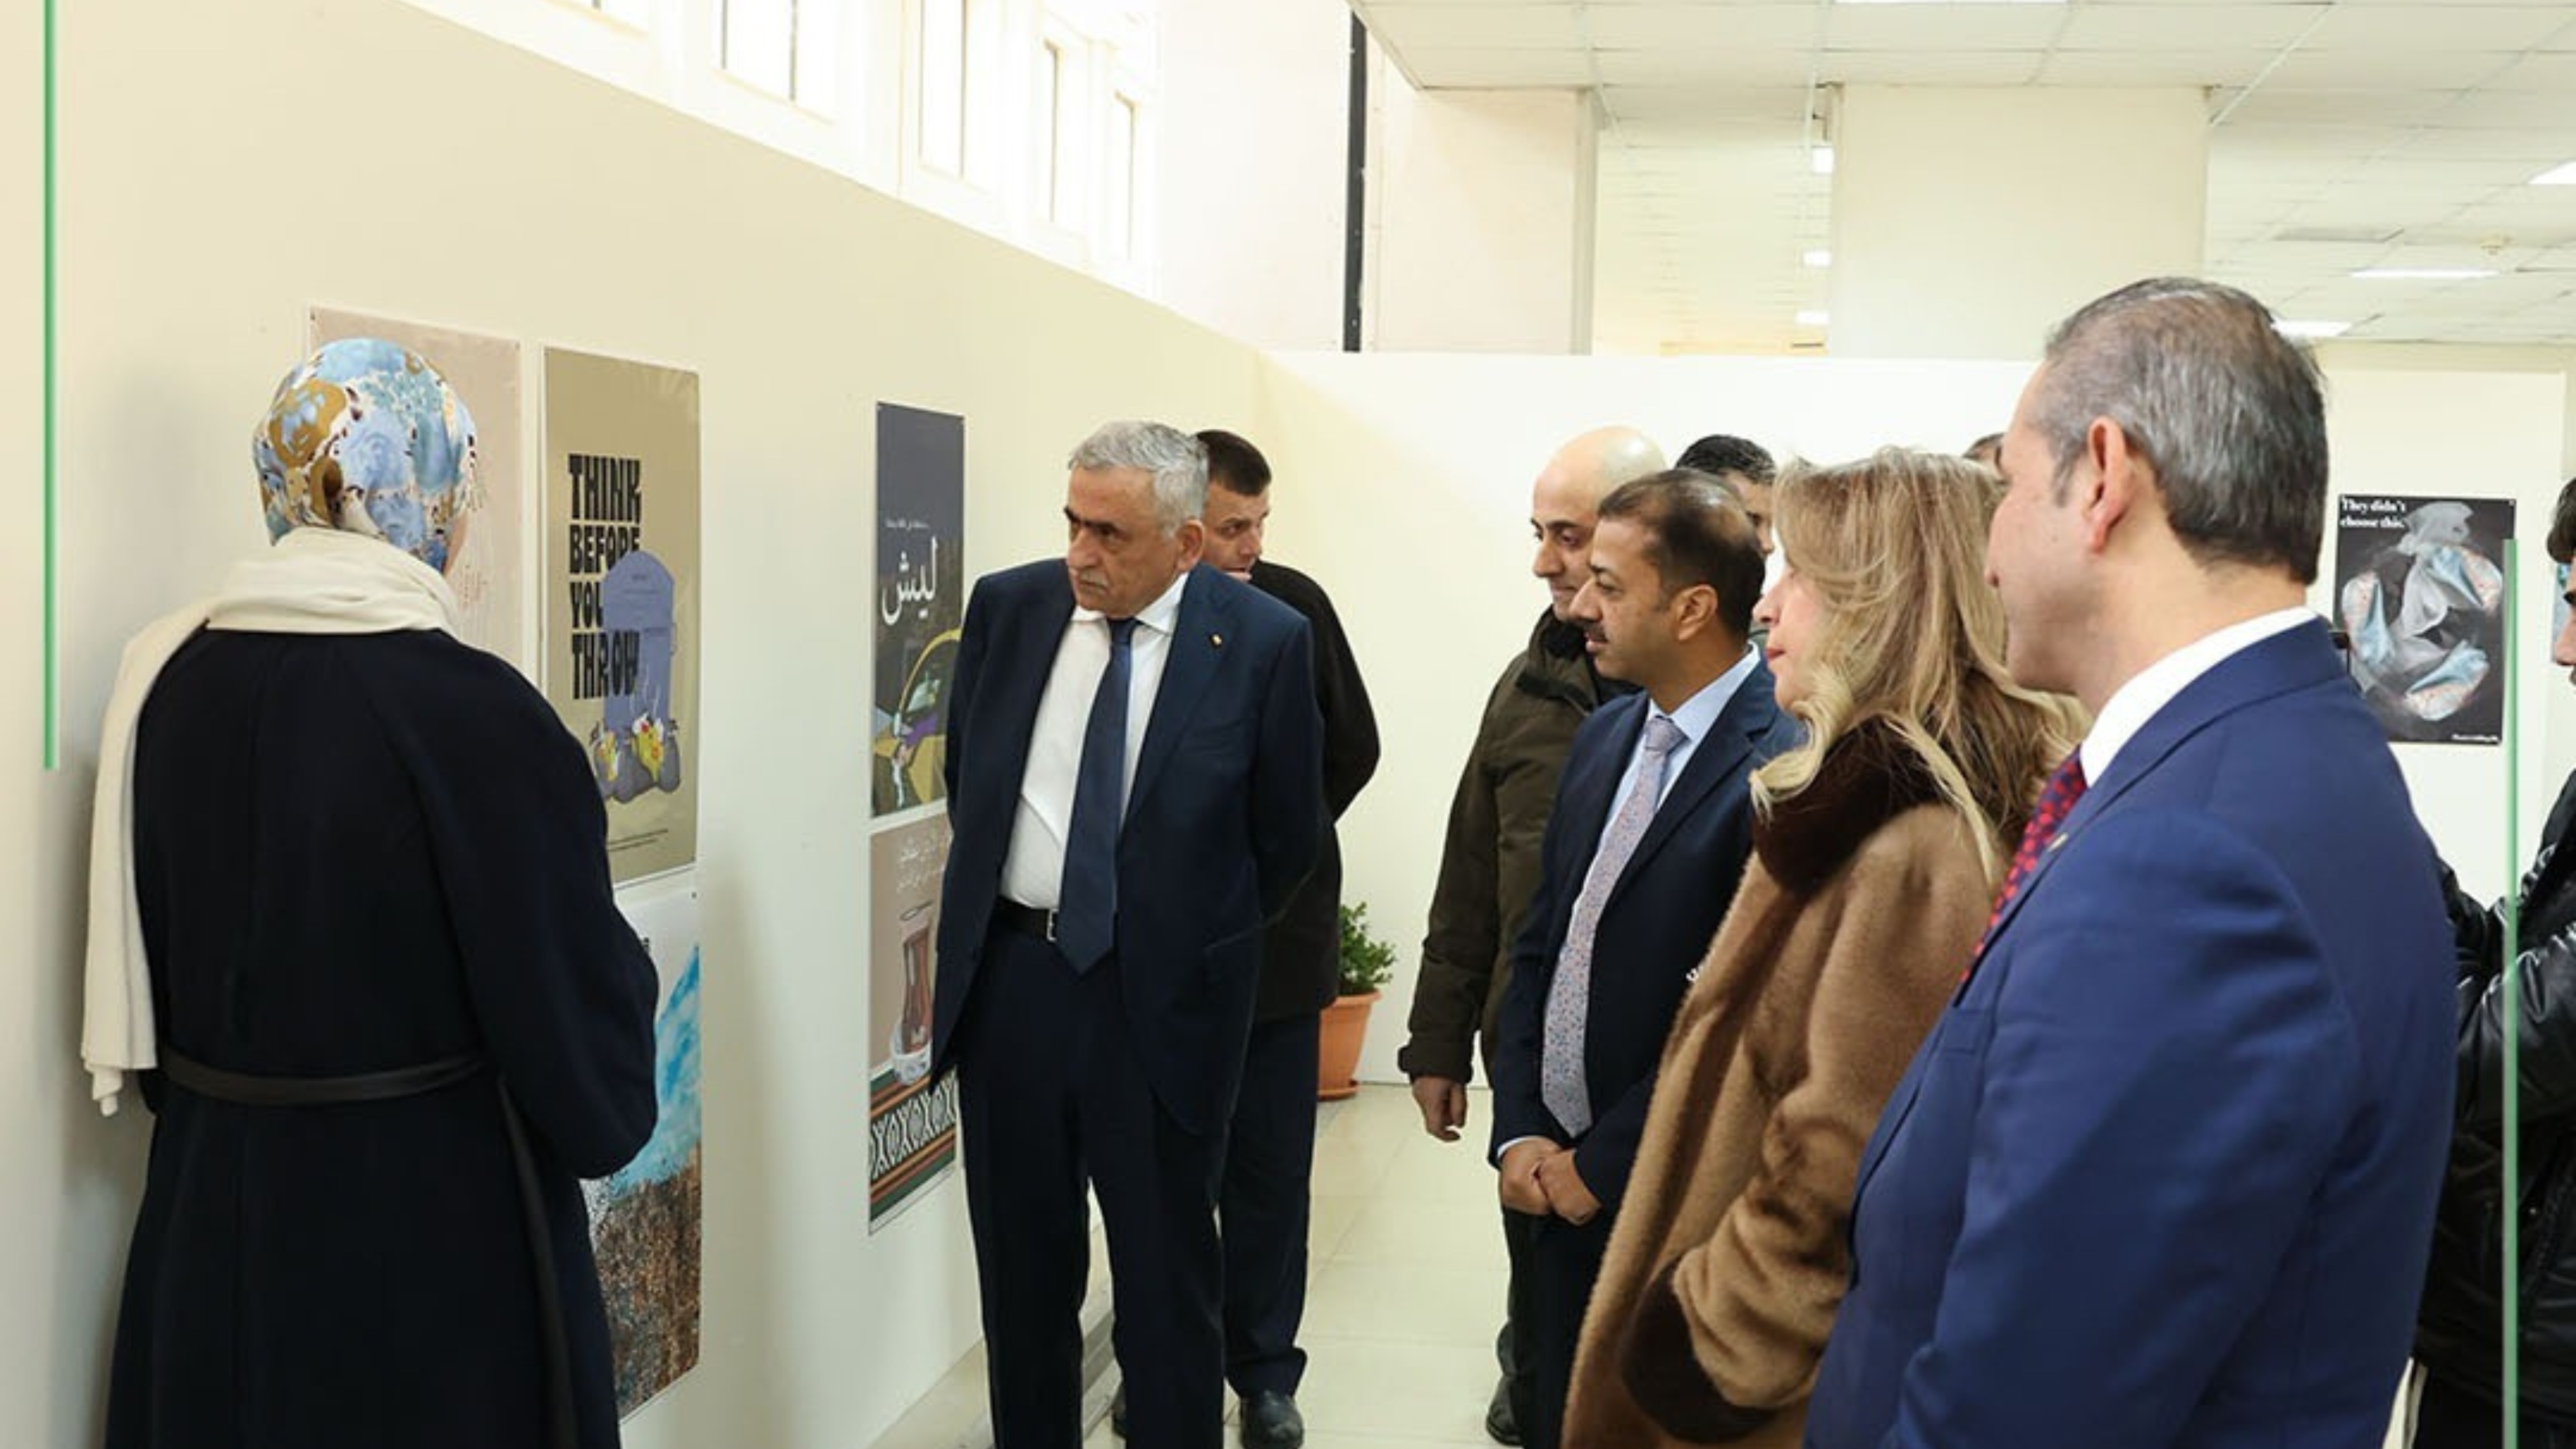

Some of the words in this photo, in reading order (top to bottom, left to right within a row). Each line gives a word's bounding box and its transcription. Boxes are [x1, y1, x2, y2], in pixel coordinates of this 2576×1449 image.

[569, 453, 641, 525] THINK
[2342, 497, 2366, 515] They
[2370, 499, 2405, 512] didn't
[570, 525, 640, 574] BEFORE
[2340, 515, 2378, 528] choose
[881, 535, 938, 625] ليش
[572, 630, 640, 699] THROW
